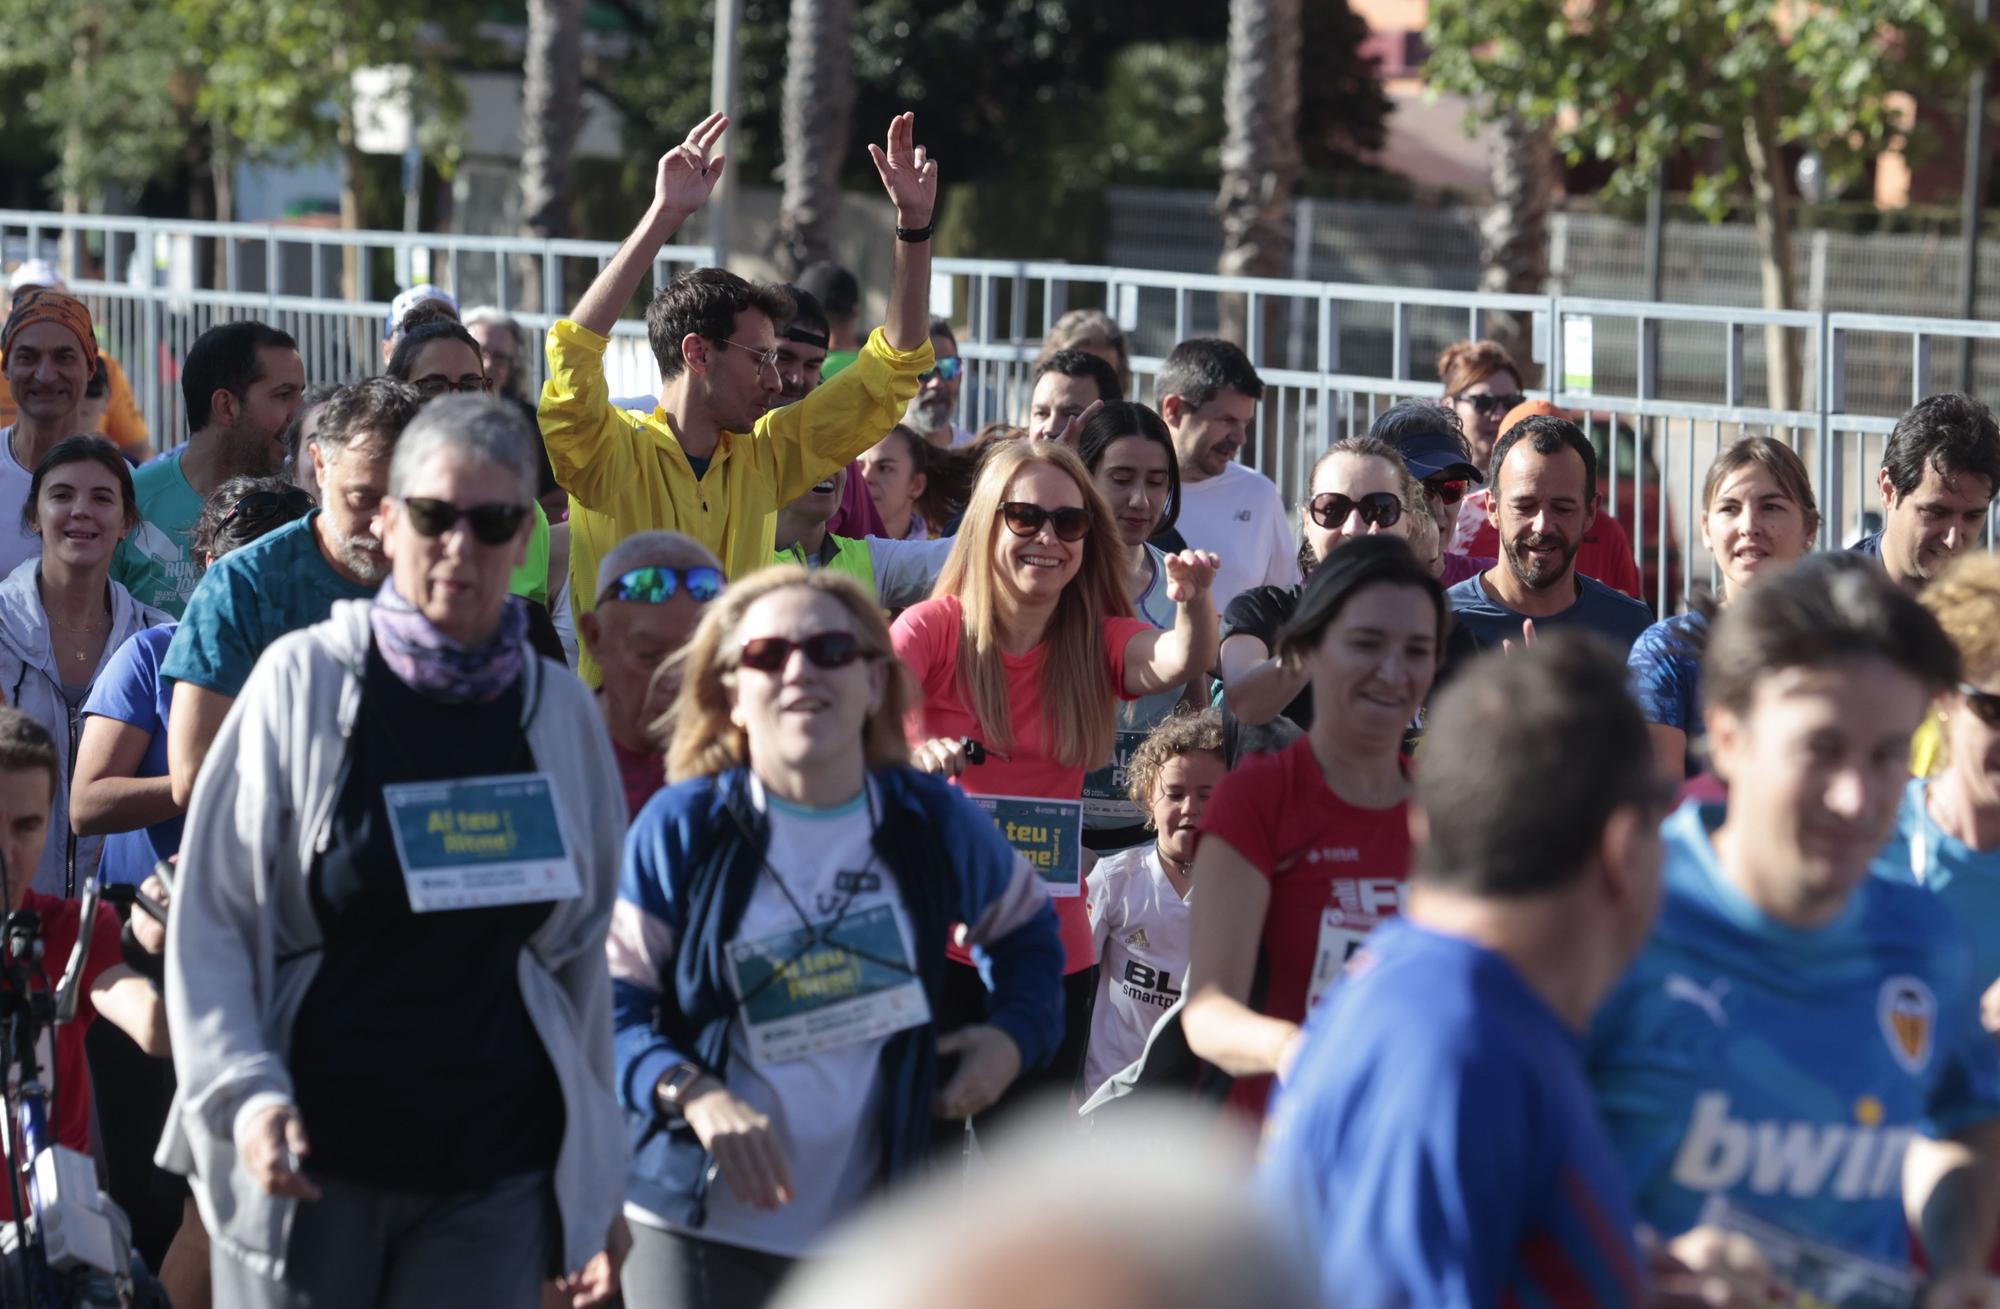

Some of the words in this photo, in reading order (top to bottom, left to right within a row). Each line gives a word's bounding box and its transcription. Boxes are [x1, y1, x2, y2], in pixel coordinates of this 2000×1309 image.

[165, 561, 194, 577] RUN
[427, 809, 455, 834] Al
[457, 810, 499, 832] teu
[1006, 821, 1047, 843] teu
[1124, 960, 1181, 995] BL
[1123, 984, 1180, 1009] smartp
